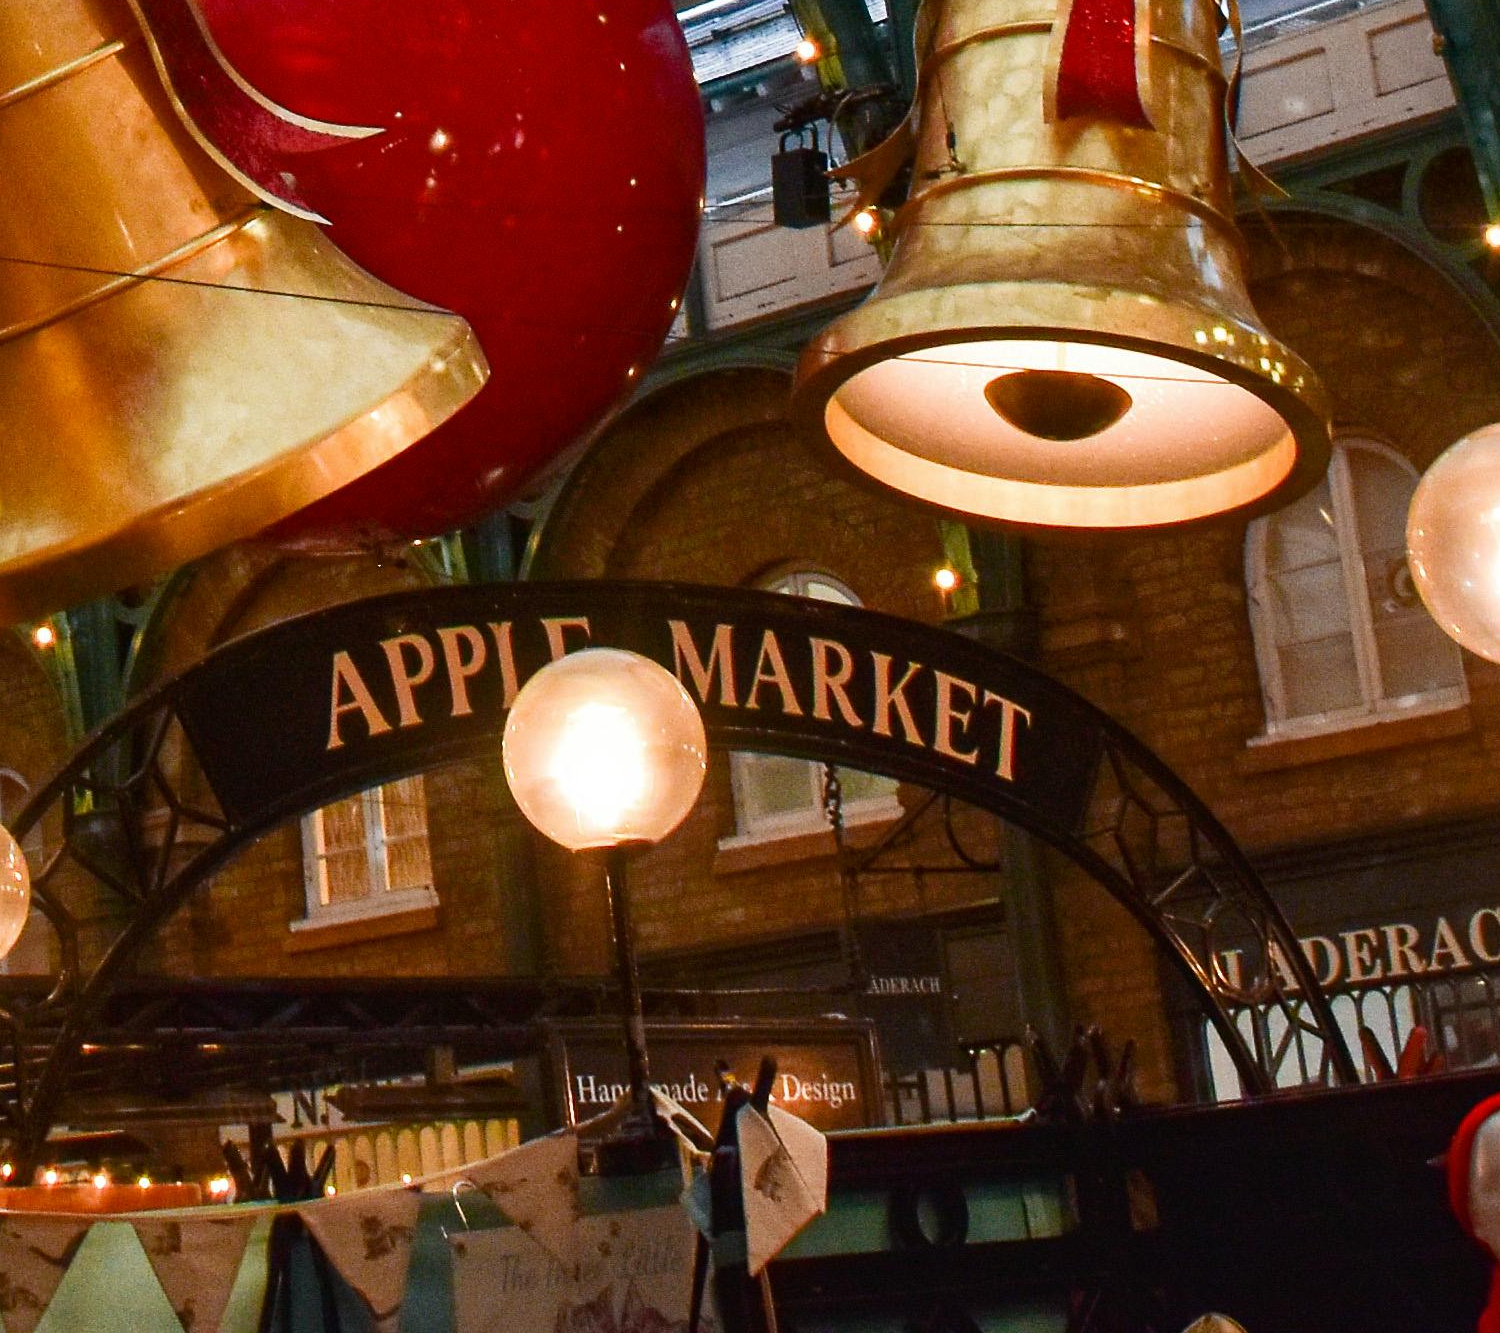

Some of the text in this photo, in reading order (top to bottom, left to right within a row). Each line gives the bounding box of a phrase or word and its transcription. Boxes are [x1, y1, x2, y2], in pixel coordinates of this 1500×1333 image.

[668, 619, 1031, 782] MARKET
[576, 1073, 709, 1103] Hanmade
[782, 1073, 856, 1109] Design
